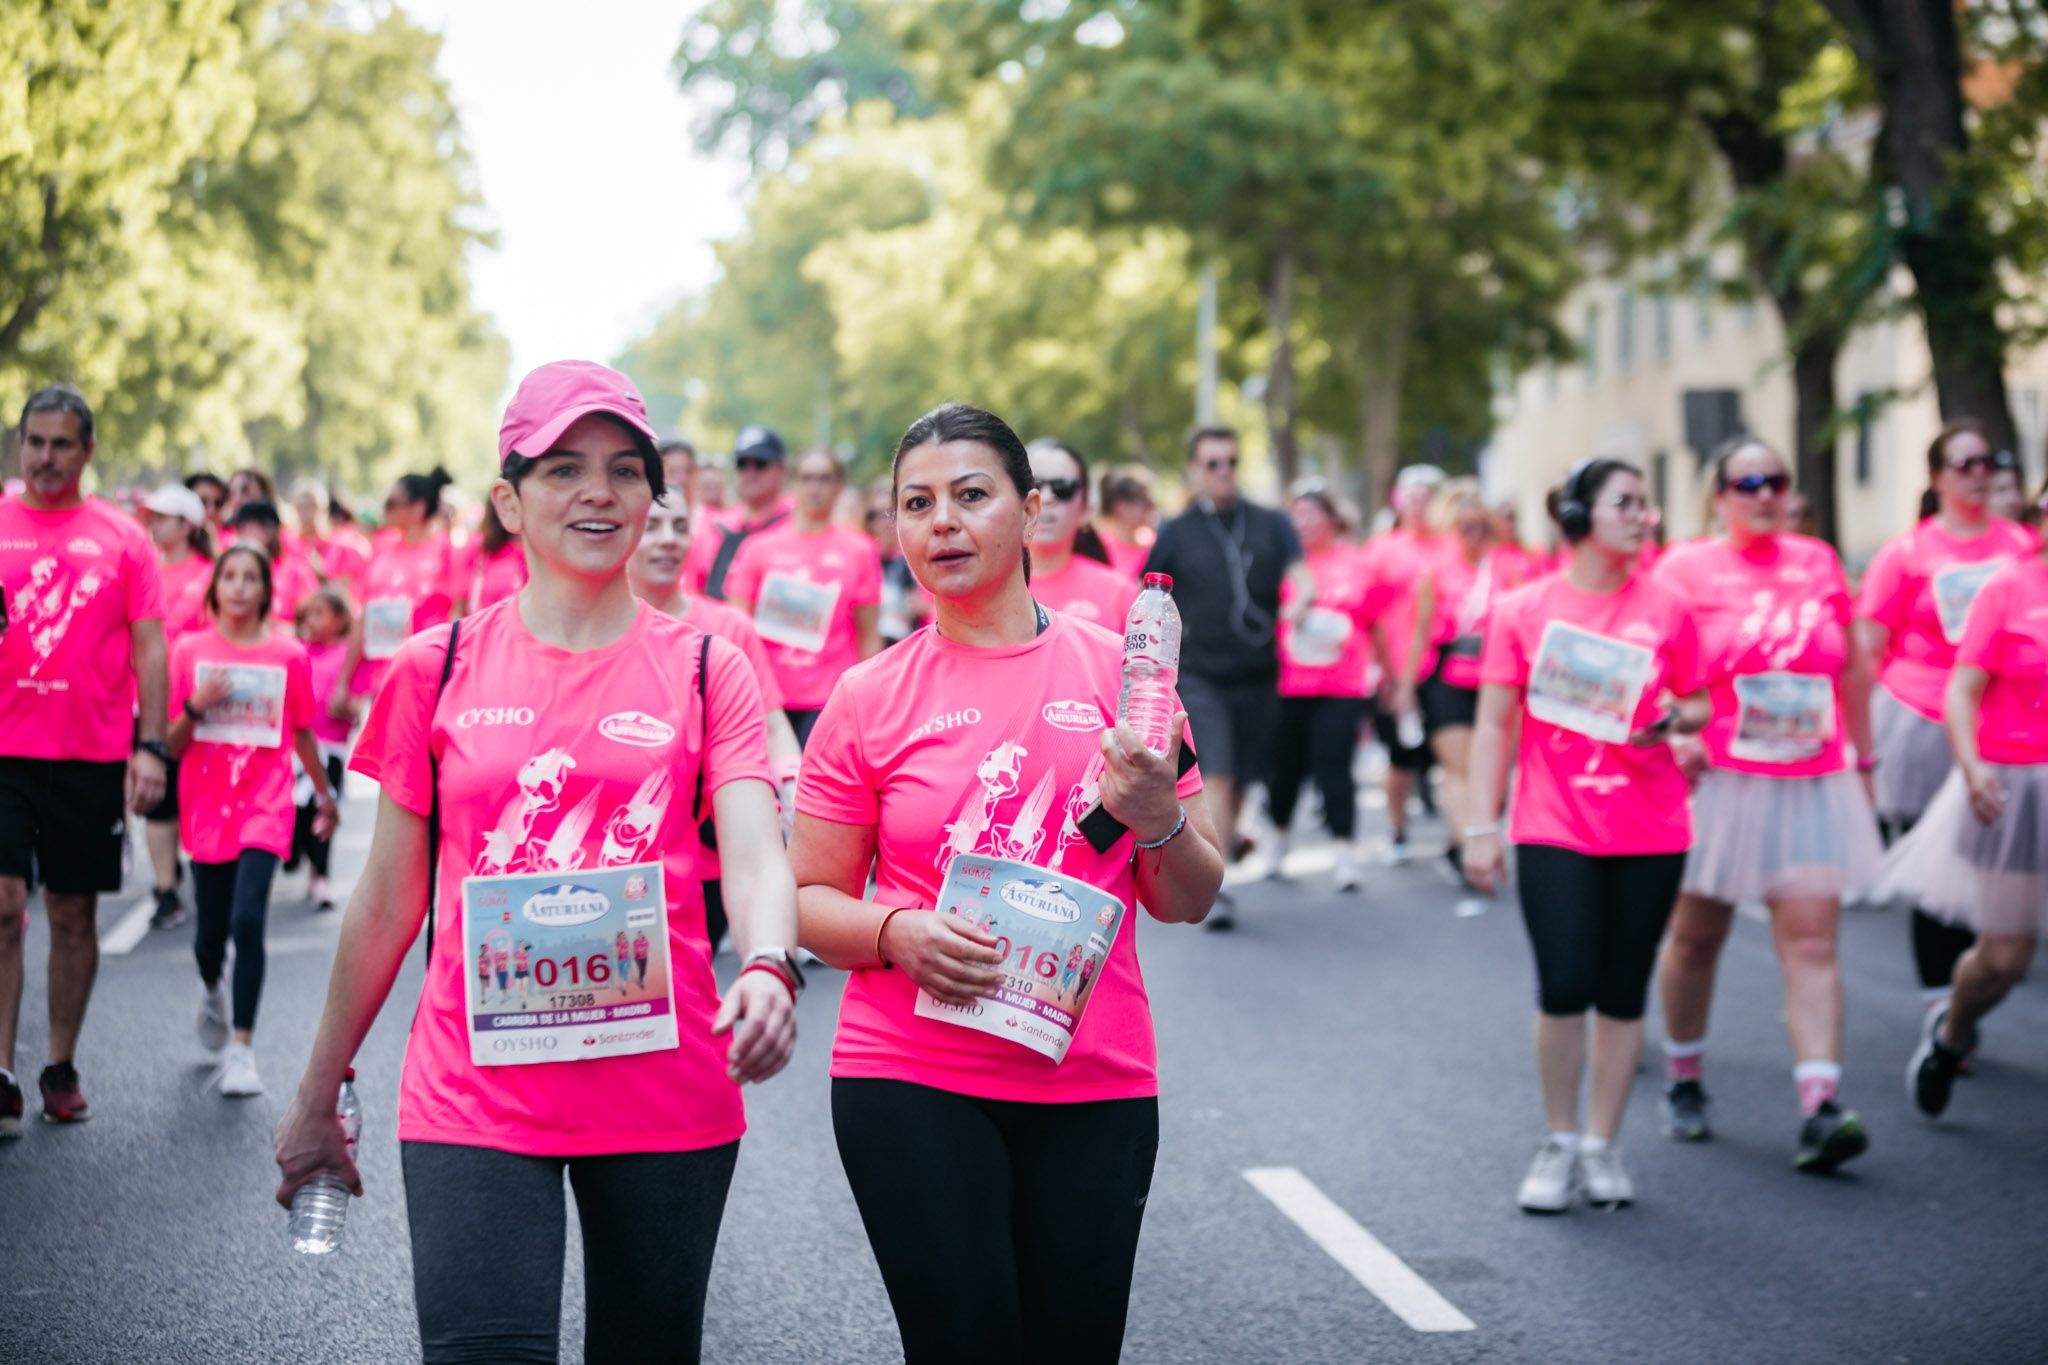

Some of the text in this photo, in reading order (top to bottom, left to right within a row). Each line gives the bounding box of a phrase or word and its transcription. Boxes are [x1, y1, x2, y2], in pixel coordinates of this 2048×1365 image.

[1123, 641, 1147, 651] ODIO
[1125, 633, 1147, 643] ERO
[456, 706, 534, 728] OYSHO
[907, 707, 982, 742] OYSHO
[1047, 708, 1103, 726] ASTURIANA
[961, 865, 993, 881] SUMA
[531, 901, 606, 918] ASTURIANA
[1008, 886, 1075, 921] ASTURIANA
[995, 935, 1060, 979] 016
[534, 953, 611, 987] 016
[1003, 973, 1034, 994] 310
[549, 993, 596, 1008] 17308
[1004, 992, 1037, 1010] MUJER
[540, 1012, 555, 1024] DE
[556, 1011, 570, 1023] LA
[493, 1028, 656, 1052] OYSHO Santander
[1019, 1020, 1064, 1050] Santande
